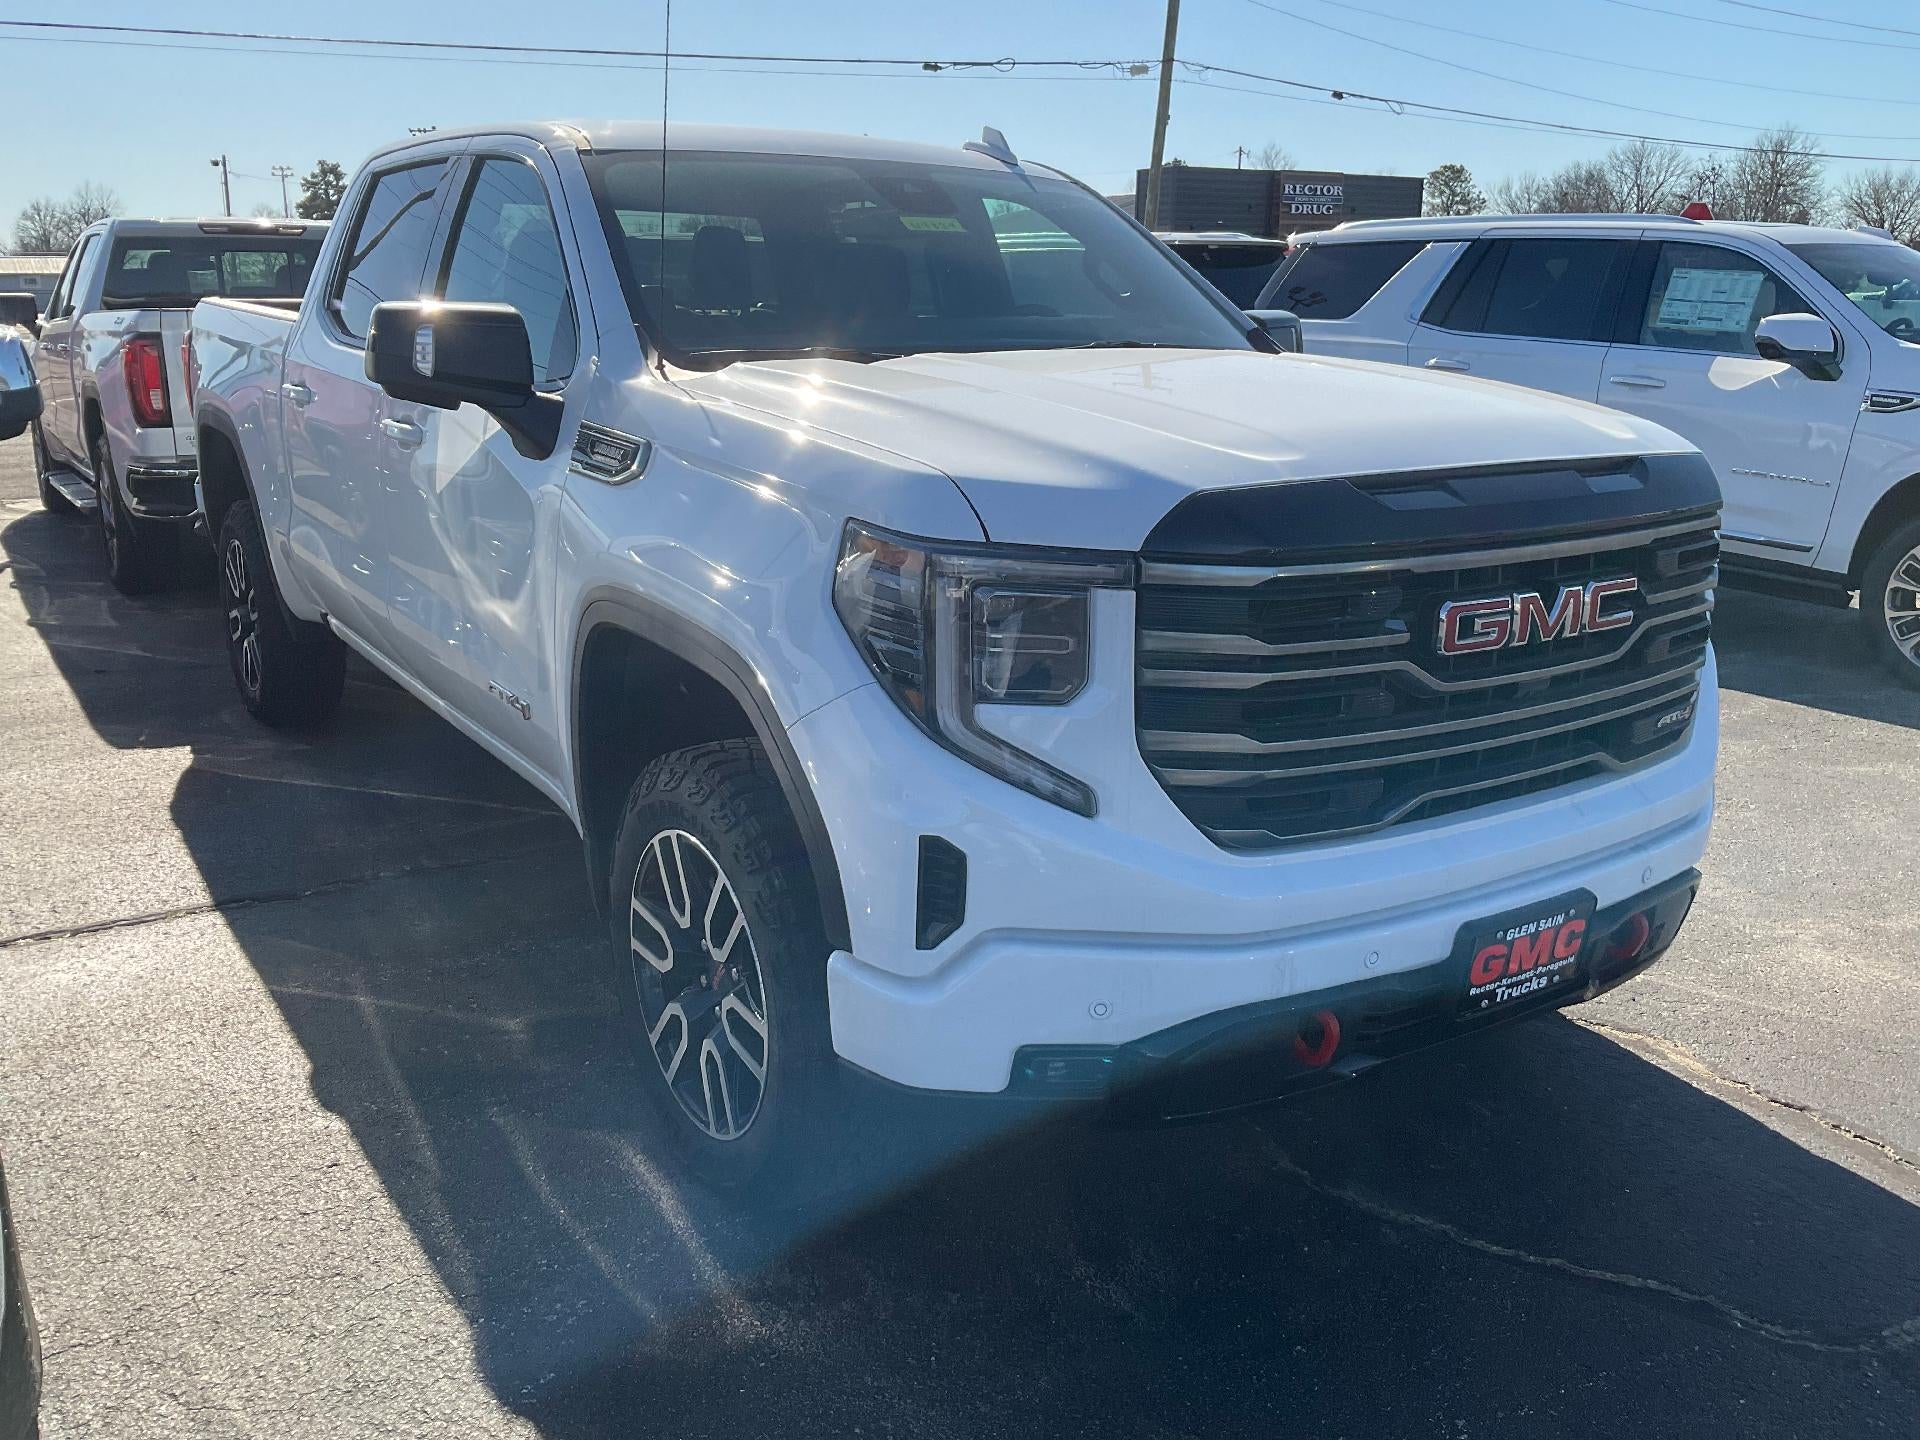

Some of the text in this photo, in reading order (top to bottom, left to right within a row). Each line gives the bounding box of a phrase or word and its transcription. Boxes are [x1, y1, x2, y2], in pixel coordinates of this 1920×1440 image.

[1283, 183, 1343, 196] RECTOR
[1291, 204, 1334, 215] DRUG
[1437, 577, 1638, 656] GMC
[1506, 912, 1565, 941] GLEN SAIN
[1469, 918, 1586, 987] GMC
[1495, 975, 1548, 1003] Trucks
